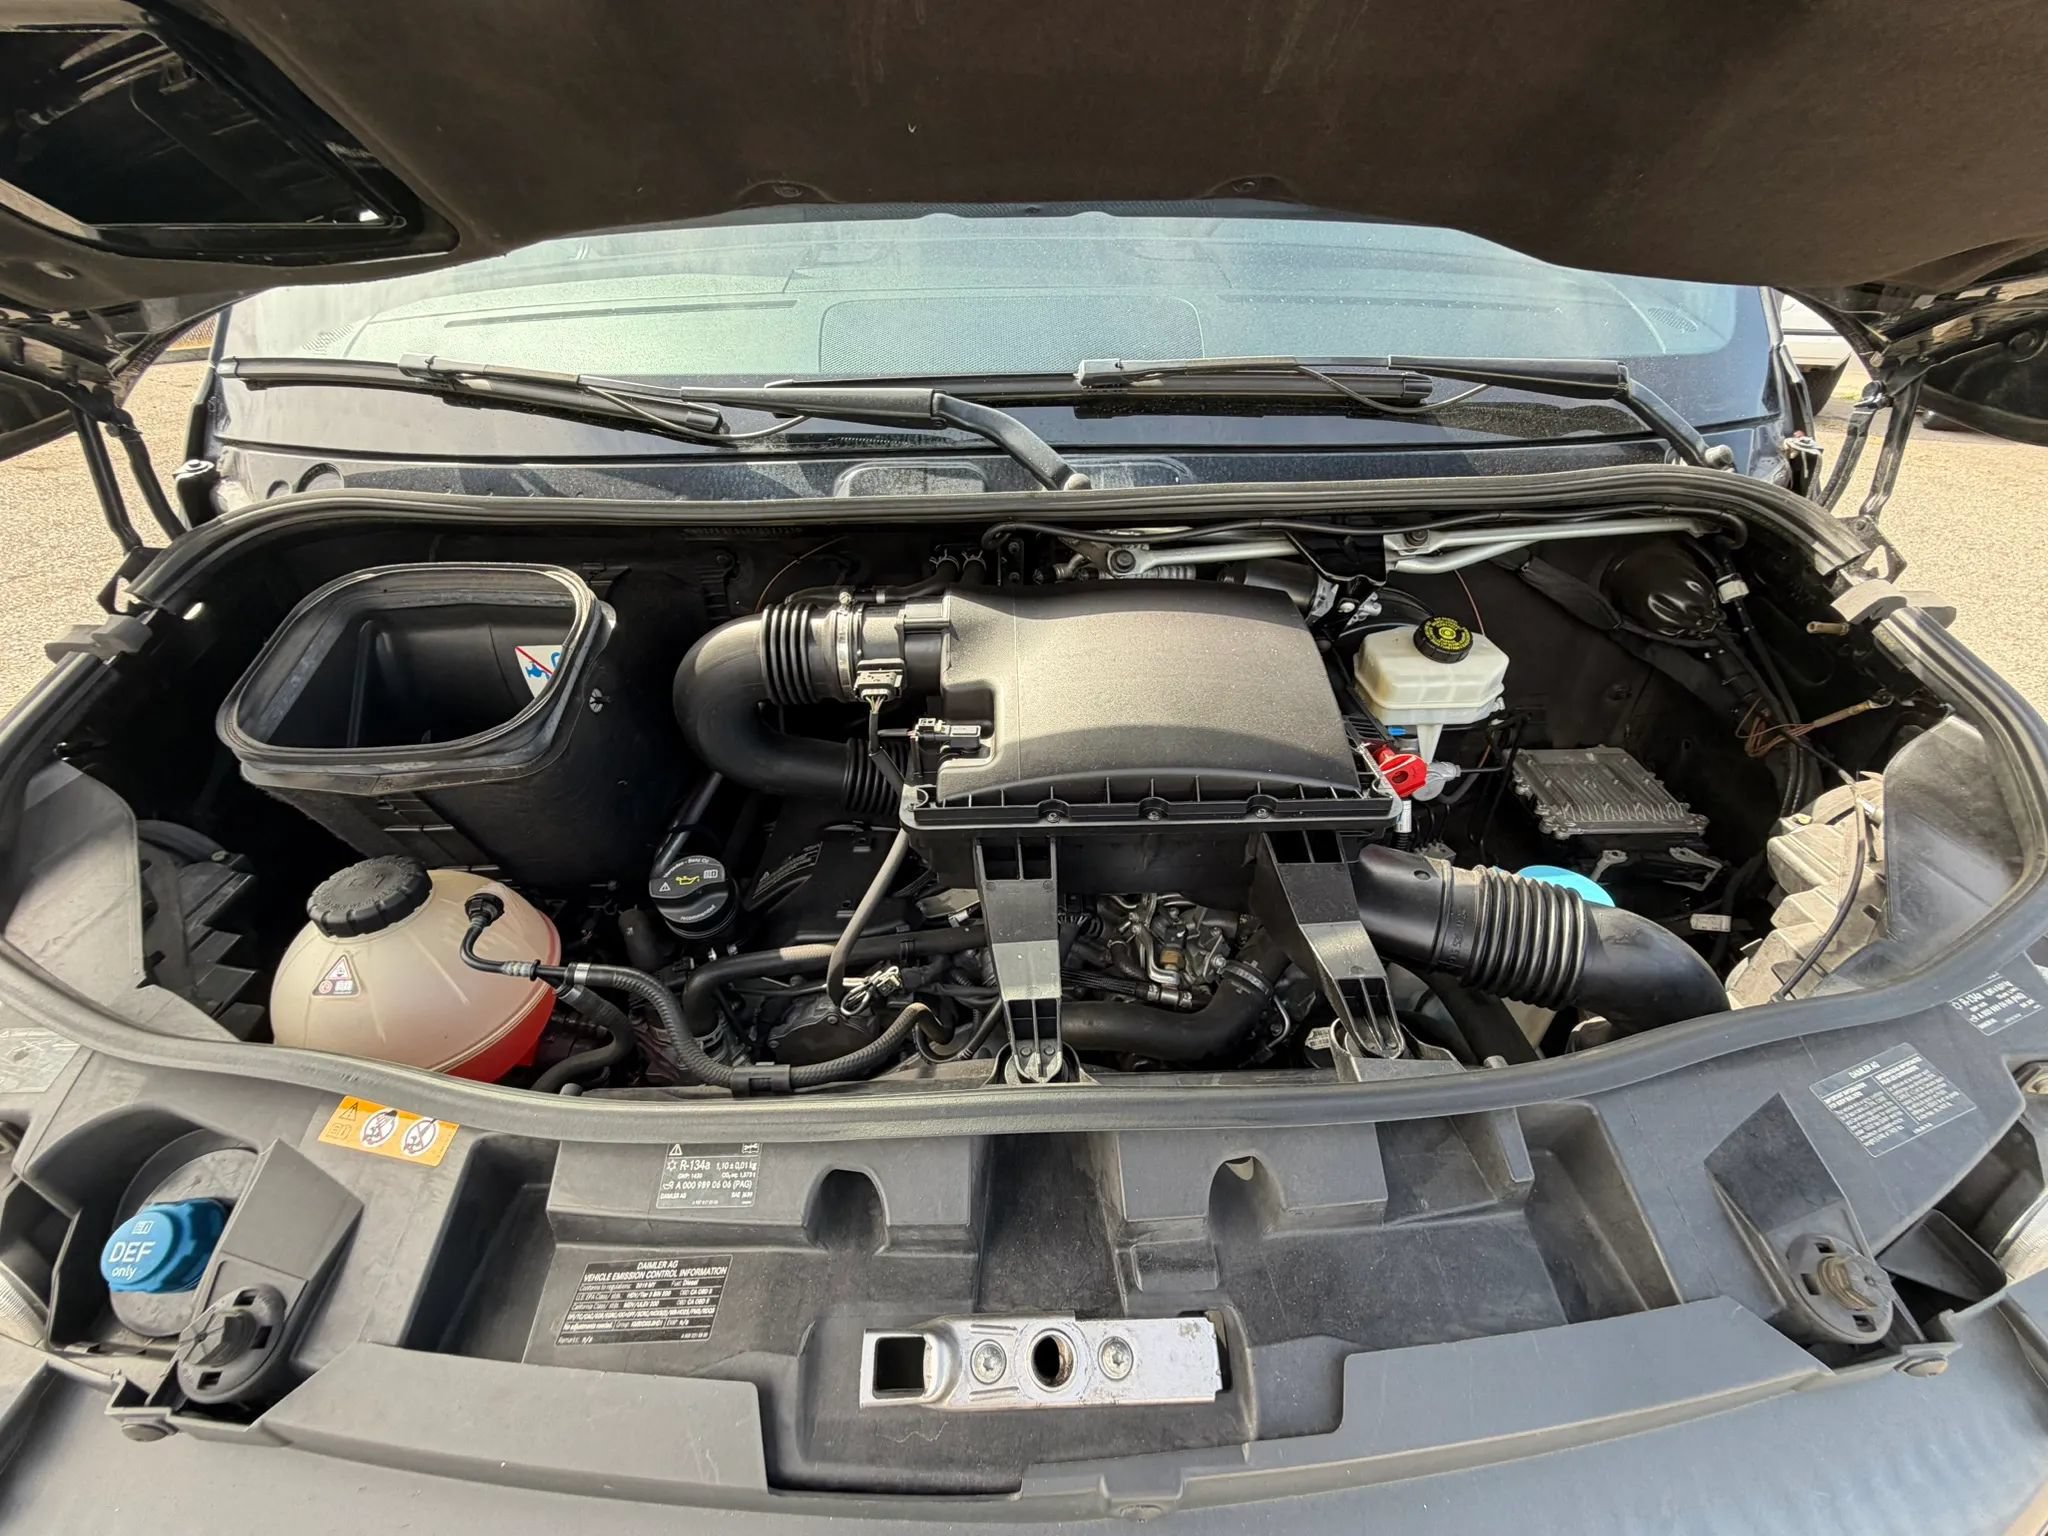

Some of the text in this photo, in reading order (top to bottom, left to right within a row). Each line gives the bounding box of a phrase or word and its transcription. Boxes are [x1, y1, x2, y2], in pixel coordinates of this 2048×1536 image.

[680, 1160, 711, 1170] R-134a
[733, 1181, 753, 1189] (PAG)
[108, 1241, 156, 1263] DEF
[637, 1261, 668, 1270] DAIMLER
[112, 1264, 137, 1280] only
[583, 1267, 728, 1282] VEHICLE EMISSION CONTROL INFORMATION
